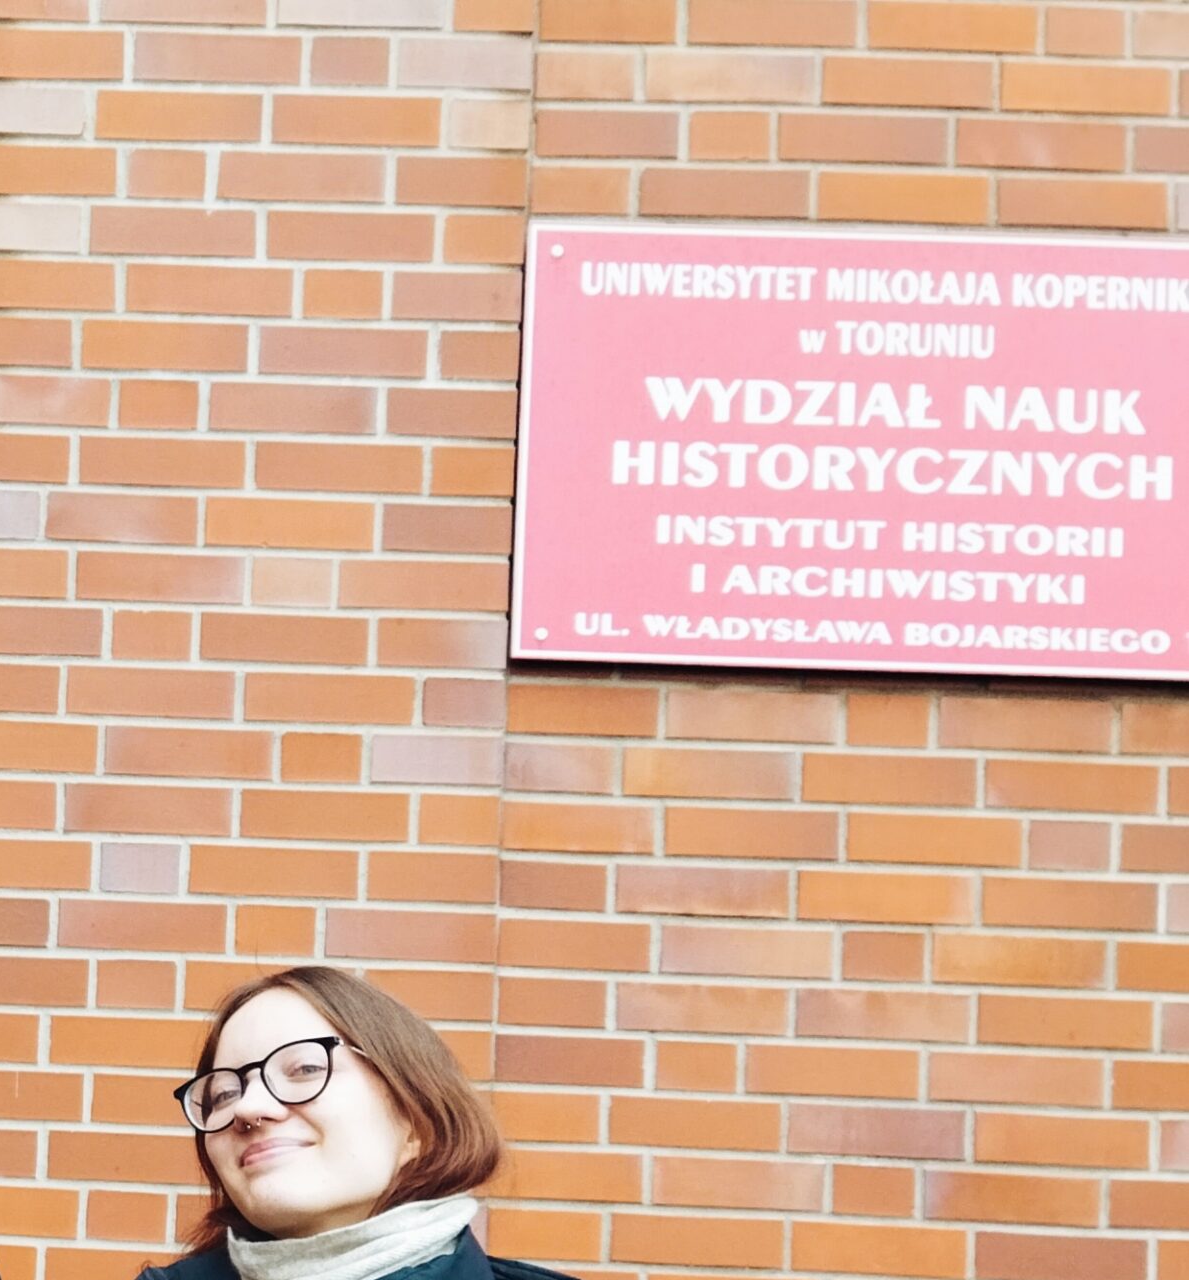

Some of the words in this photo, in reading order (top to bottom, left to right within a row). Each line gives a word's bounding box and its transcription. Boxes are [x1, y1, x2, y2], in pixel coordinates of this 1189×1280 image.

[581, 261, 817, 301] UNIWERSYTET
[826, 268, 1001, 306] MIKOŁAJA
[799, 330, 826, 353] w
[835, 321, 994, 359] TORUNIU
[645, 377, 941, 428] WYDZIAŁ
[964, 385, 1145, 435] NAUK
[612, 440, 1173, 500] HISTORYCZNYCH
[656, 515, 886, 550] INSTYTUT
[903, 522, 1123, 557] HISTORII
[691, 564, 705, 592] I
[722, 565, 1085, 604] ARCHIWISTYKI
[575, 613, 629, 636] UL.
[643, 615, 892, 644] WŁADYSŁAWA
[904, 623, 1170, 654] BOJARSKIEGO
